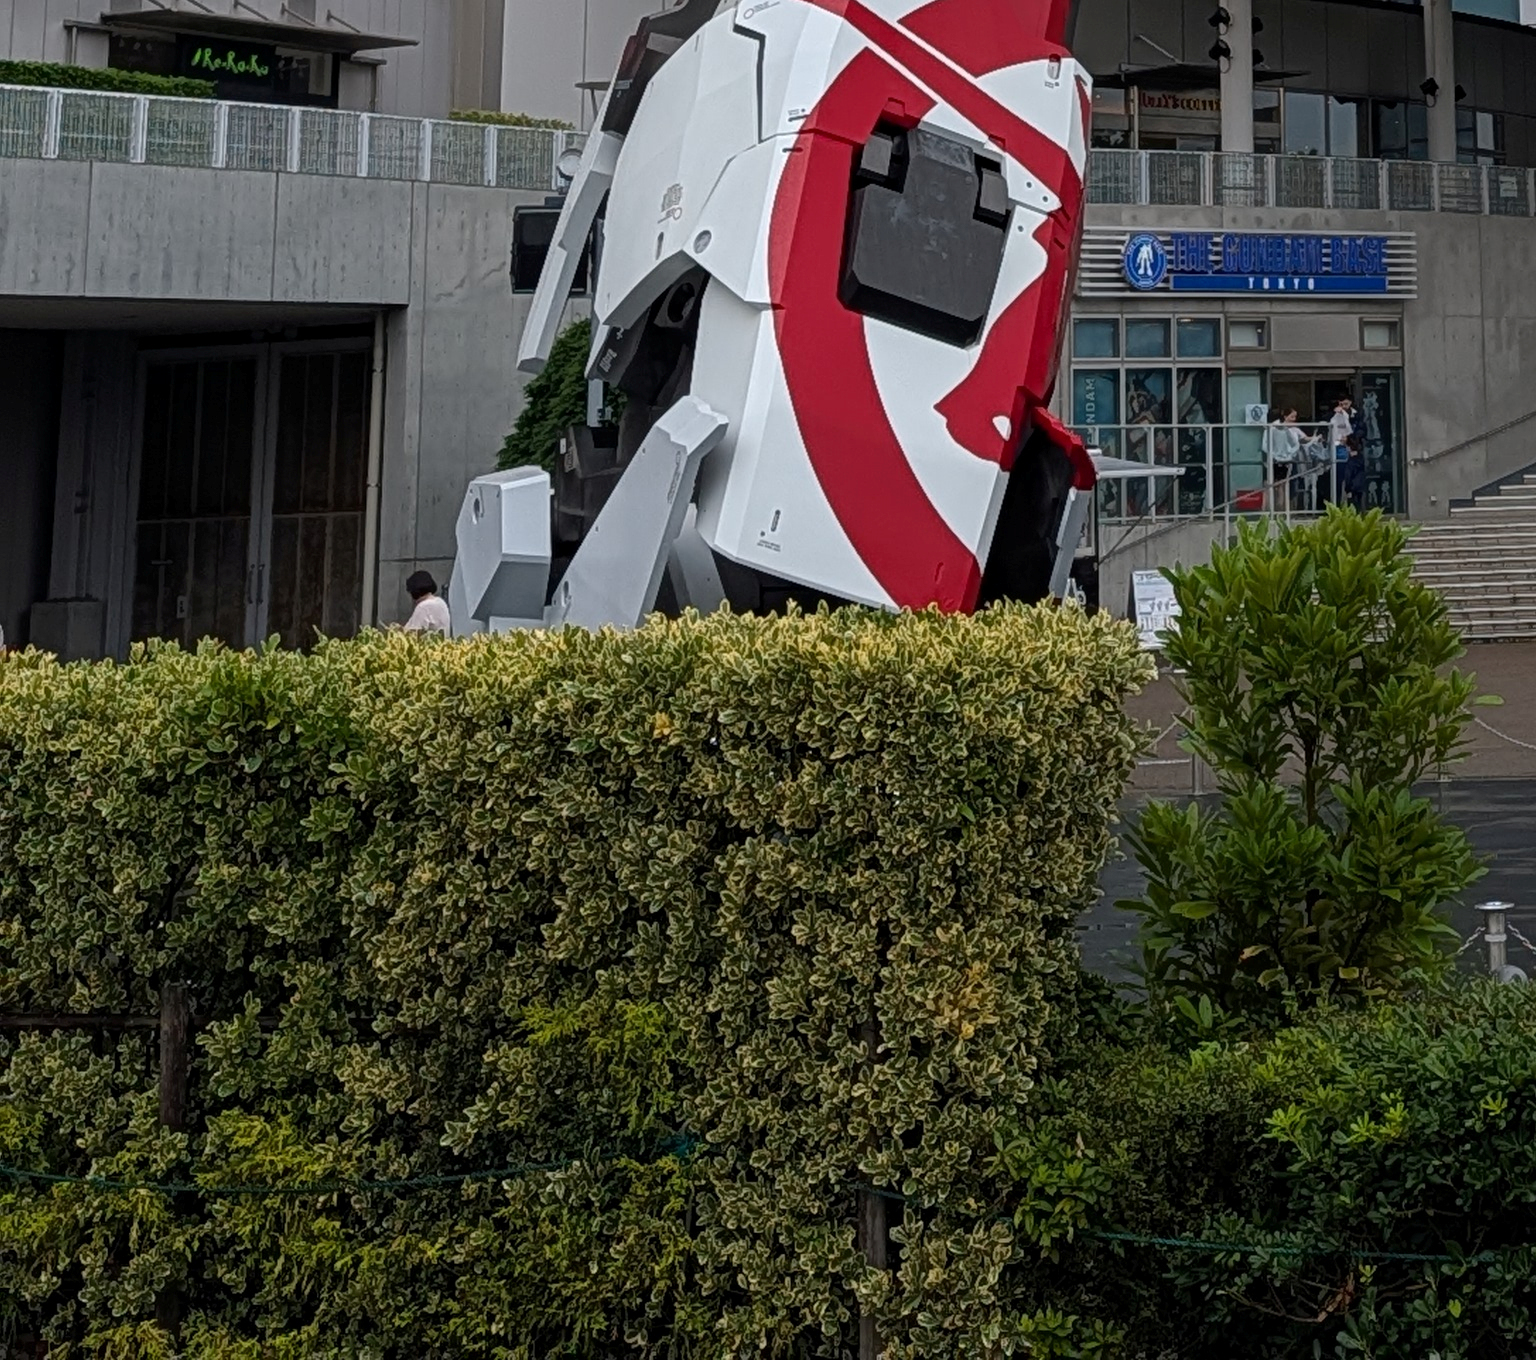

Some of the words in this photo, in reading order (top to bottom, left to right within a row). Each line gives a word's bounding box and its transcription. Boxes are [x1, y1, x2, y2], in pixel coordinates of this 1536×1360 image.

[1170, 233, 1214, 272] THE
[1221, 234, 1323, 274] GUNDAM
[1330, 236, 1389, 274] BASE
[1248, 277, 1315, 290] TOKYO
